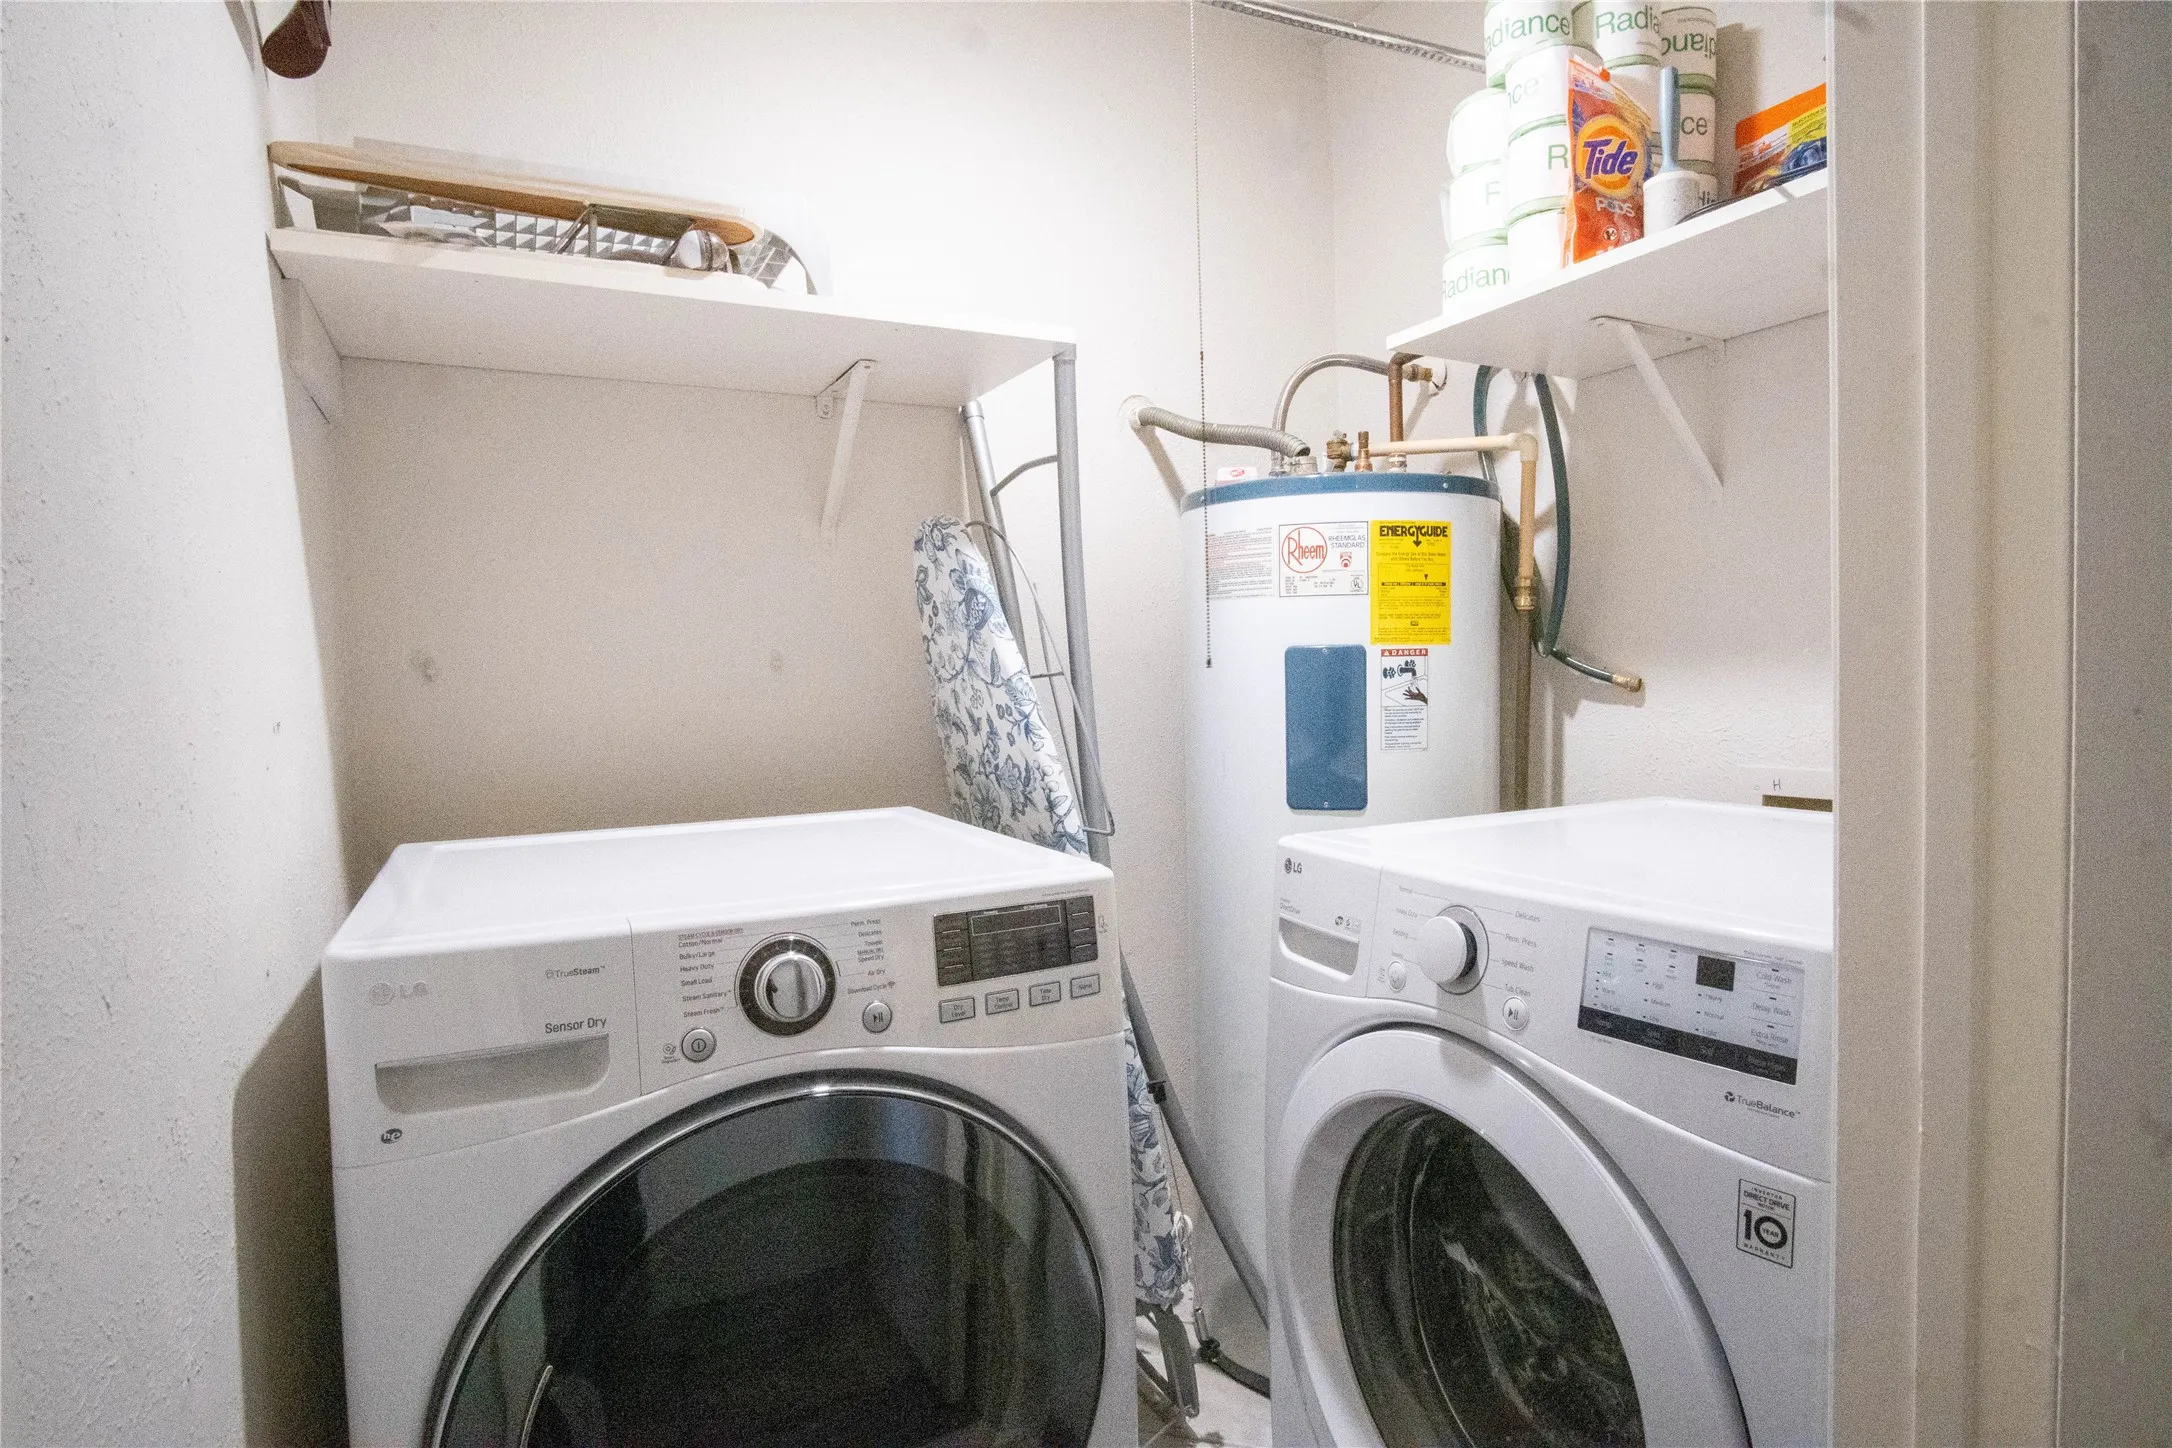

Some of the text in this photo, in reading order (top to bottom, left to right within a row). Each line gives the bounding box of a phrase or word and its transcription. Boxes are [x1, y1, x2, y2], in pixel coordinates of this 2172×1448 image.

[1583, 138, 1639, 180] Tide
[1379, 525, 1448, 538] ENERGYGUIDE
[1328, 534, 1366, 542] RHEEMGLAS
[1287, 529, 1326, 567] Rheem
[1331, 541, 1365, 549] STANDARD
[1773, 779, 1782, 791] H
[1293, 861, 1303, 874] LG
[1515, 911, 1540, 922] Delicates
[678, 938, 723, 948] Cotton/Normal
[1521, 937, 1537, 947] Press
[679, 951, 715, 961] Bulky/Large
[700, 963, 715, 971] Duty
[1501, 957, 1535, 973] Speed Wash
[681, 977, 713, 987] Small Load
[1756, 972, 1792, 984] Cold Wash
[1515, 986, 1531, 997] Clean
[682, 995, 702, 1003] Steam
[683, 1010, 703, 1019] Steam
[1752, 1002, 1792, 1017] Delay Wash
[545, 1016, 607, 1034] Sensor Dry
[1750, 1029, 1769, 1039] Extra
[1770, 1032, 1789, 1044] Rinse
[382, 1129, 402, 1143] he
[1743, 1190, 1791, 1212] DIRECT DRIVE
[1743, 1208, 1788, 1250] 10
[1761, 1226, 1780, 1239] YEAR
[1743, 1242, 1786, 1262] WARRANTY
